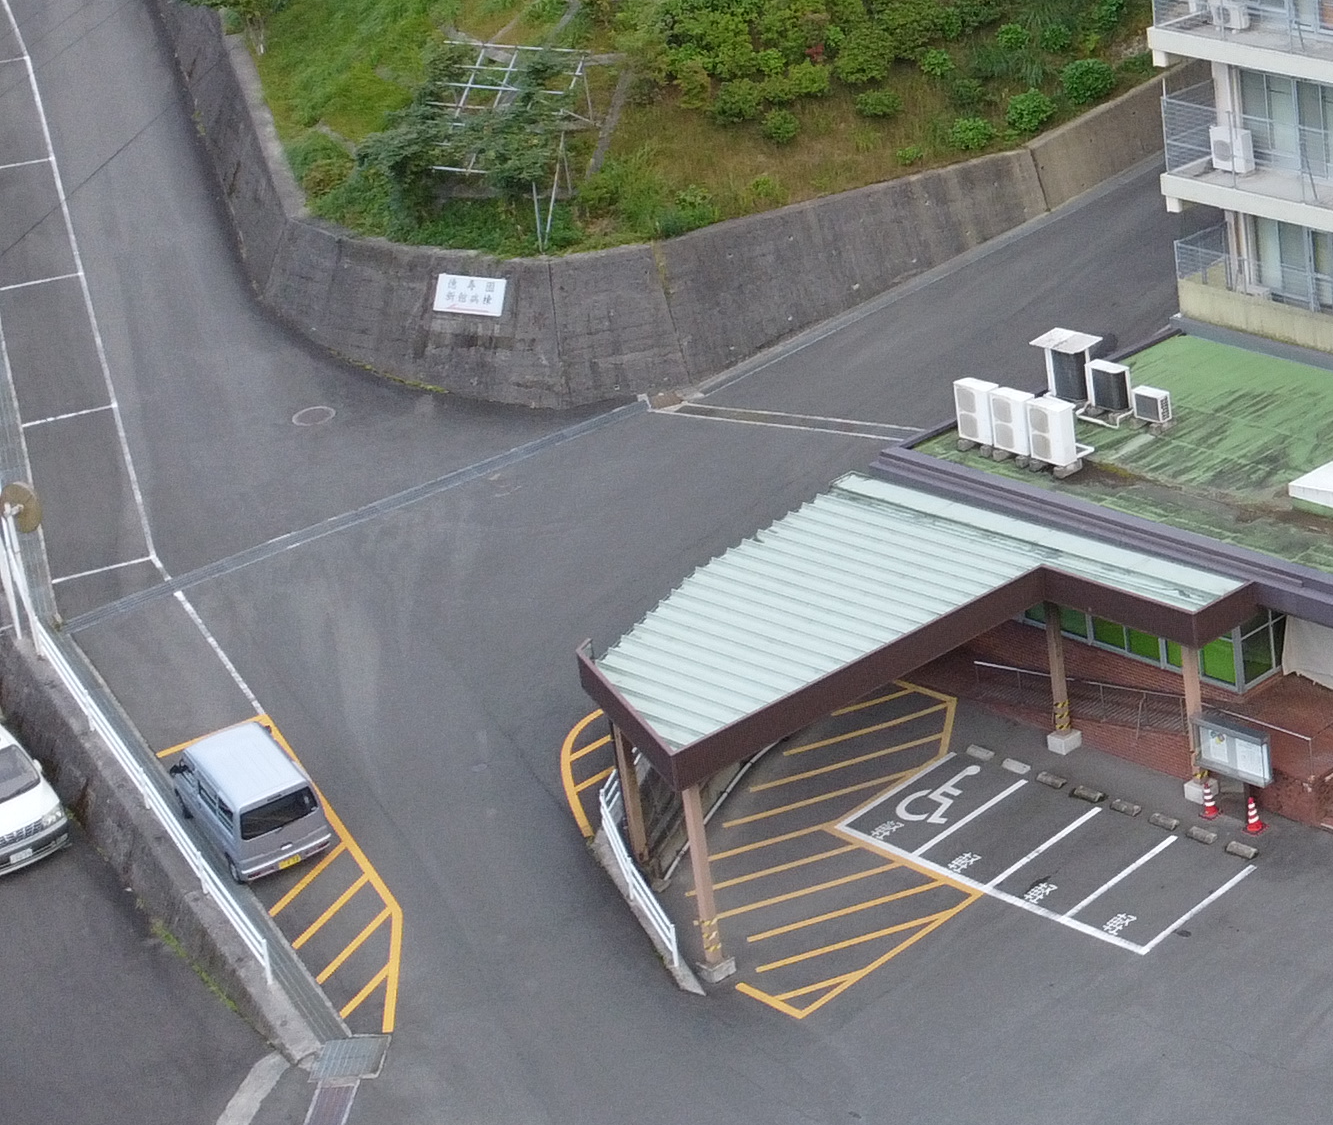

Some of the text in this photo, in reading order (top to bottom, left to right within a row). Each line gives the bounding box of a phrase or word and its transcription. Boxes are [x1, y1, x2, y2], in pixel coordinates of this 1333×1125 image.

[948, 851, 982, 873] 軽
[1024, 882, 1058, 904] 軽
[1103, 912, 1137, 935] 軽
